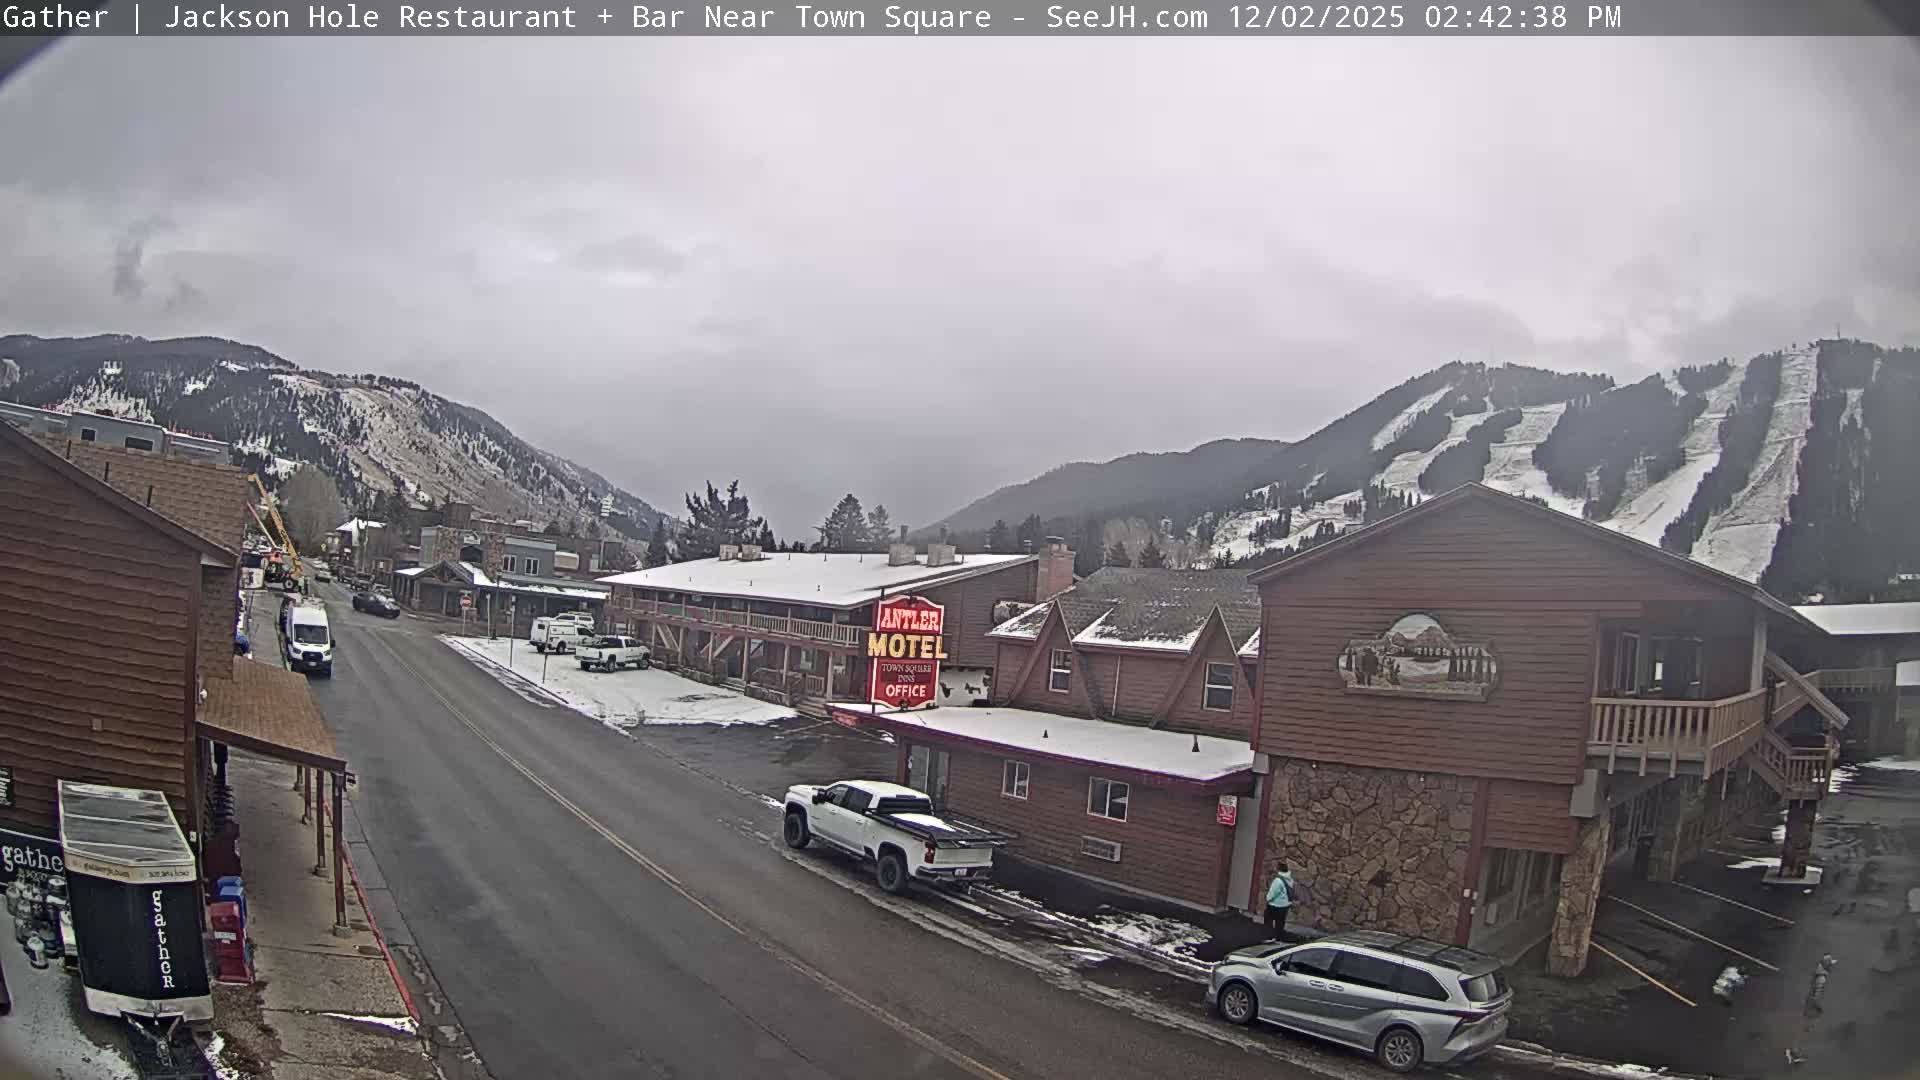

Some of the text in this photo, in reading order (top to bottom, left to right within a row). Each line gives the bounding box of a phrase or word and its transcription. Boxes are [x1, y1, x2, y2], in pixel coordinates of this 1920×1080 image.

[880, 608, 939, 631] ANTLER
[867, 633, 948, 659] MOTEL
[881, 663, 932, 675] TOWN SQUARE
[897, 674, 915, 683] INNS
[885, 684, 926, 697] OFFICE
[2, 846, 64, 872] gathe
